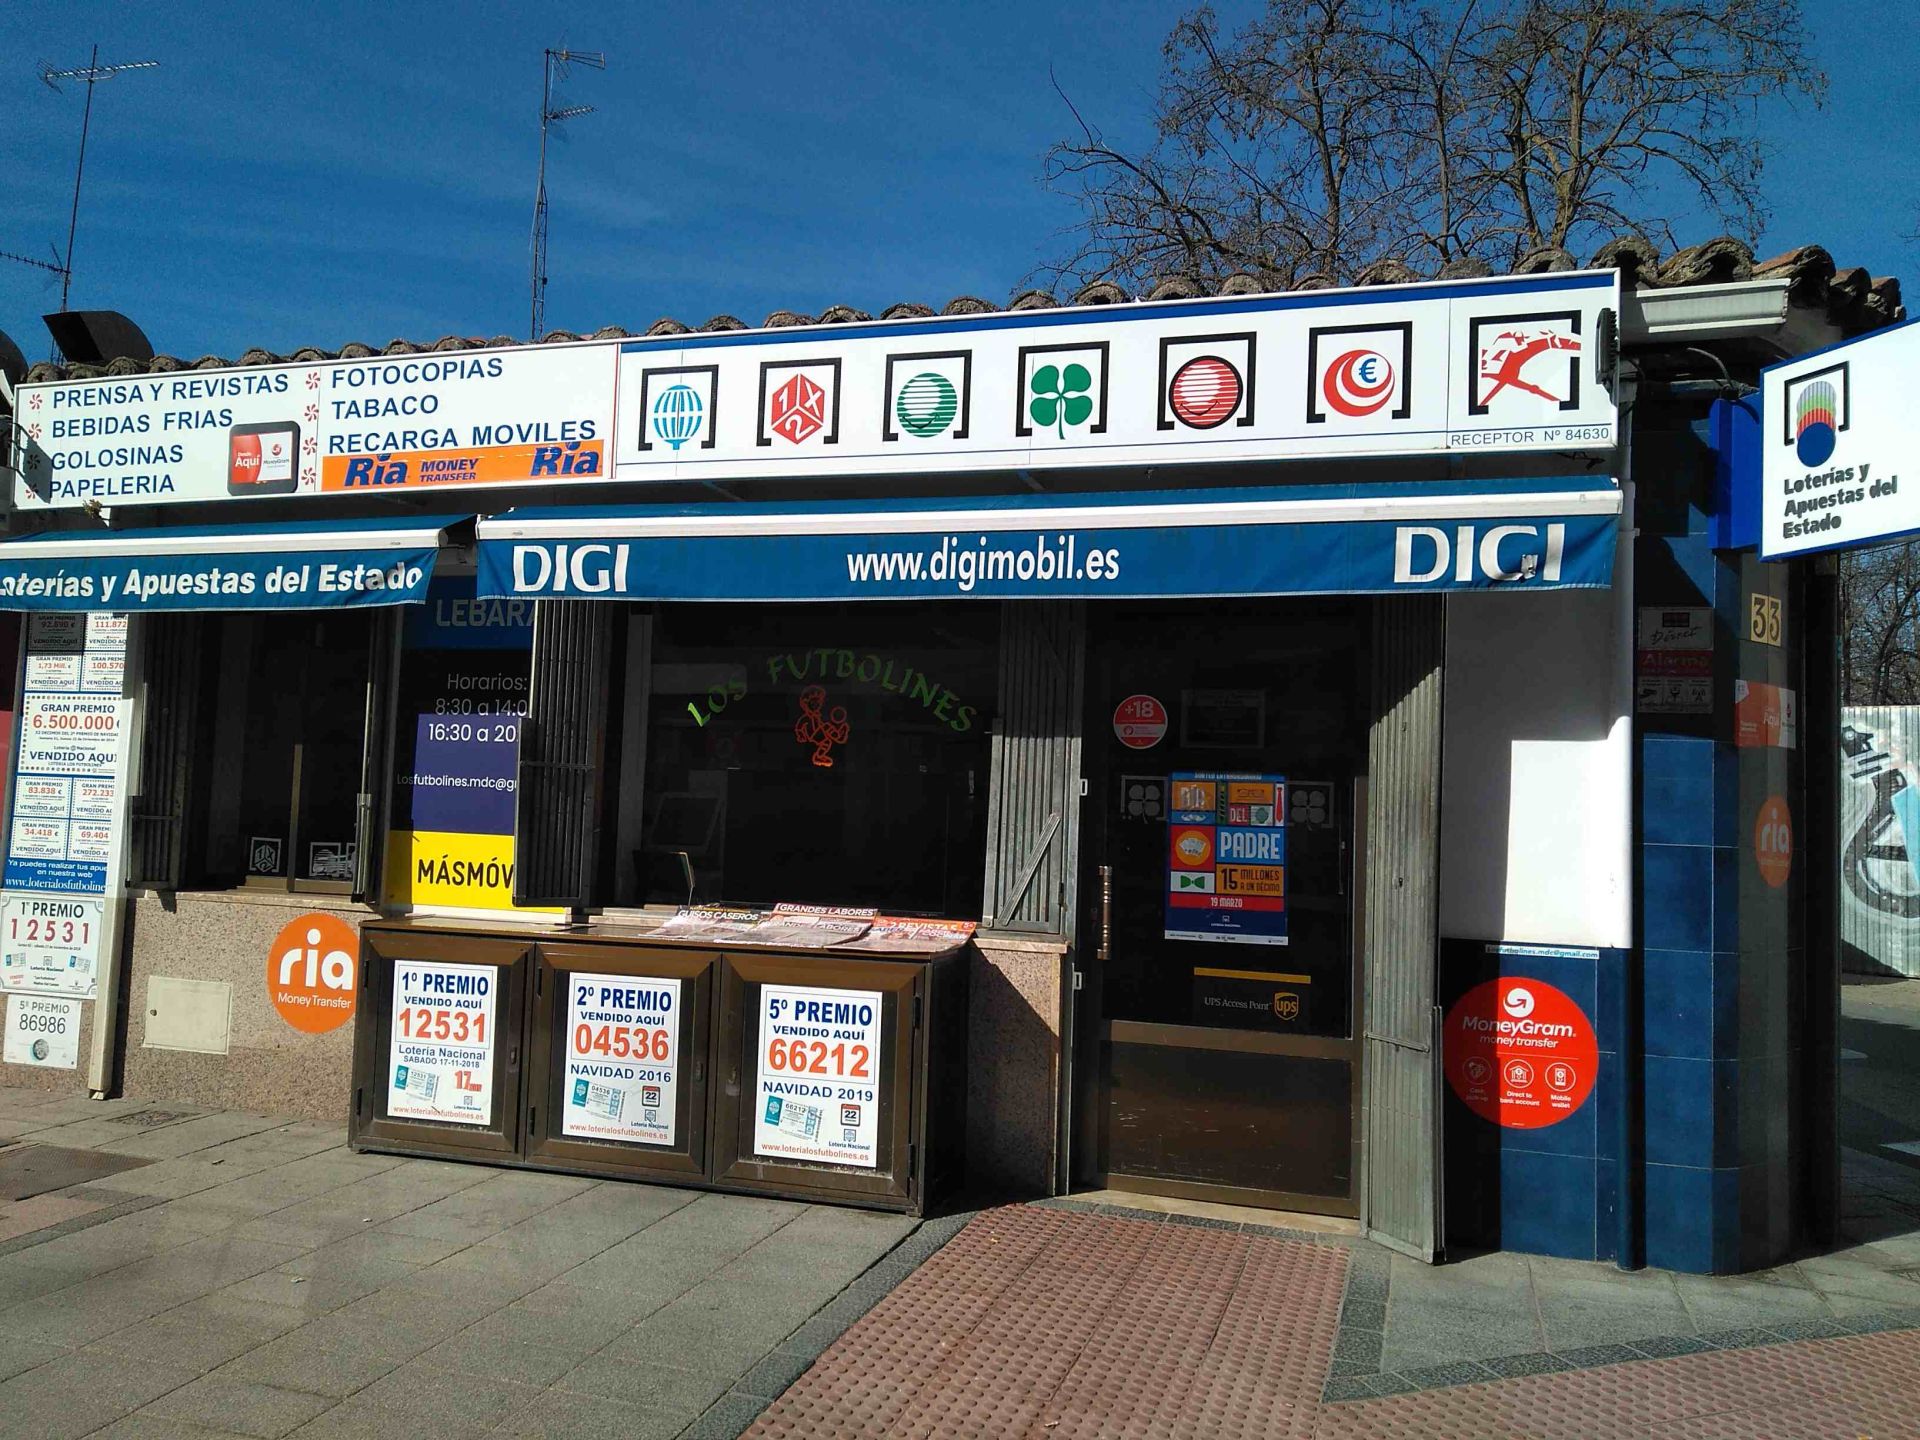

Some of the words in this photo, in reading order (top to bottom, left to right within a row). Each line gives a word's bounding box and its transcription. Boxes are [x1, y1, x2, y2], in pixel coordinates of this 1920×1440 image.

[332, 357, 503, 388] FOTOCOPIAS
[53, 385, 143, 408] PRENSA
[150, 383, 164, 401] Y
[172, 373, 289, 400] REVISTAS
[332, 394, 438, 420] TABACO
[52, 414, 150, 438] BEBIDAS
[163, 408, 233, 431] FRIAS
[329, 428, 458, 454] RECARGA
[472, 419, 596, 446] MOVILES
[1451, 431, 1534, 445] RECEPTOR
[1565, 427, 1609, 441] 84630
[51, 444, 184, 470] GOLOSINAS
[235, 454, 261, 469] Aquí
[420, 458, 479, 472] MONEY
[531, 441, 600, 476] Ria
[344, 454, 408, 486] Ria
[420, 472, 476, 482] TRANSFER
[50, 474, 175, 498] PAPELERIA
[1784, 467, 1854, 495] Loterías
[1859, 464, 1870, 482] y
[1784, 487, 1864, 518] Apuestas
[1869, 475, 1897, 499] del
[1783, 513, 1842, 538] Estado
[512, 545, 629, 592] DIGI
[847, 536, 1119, 591] www.digimobil.es
[100, 576, 116, 602] y
[123, 567, 255, 600] Apuestas
[265, 565, 307, 593] del
[319, 562, 422, 592] Estado
[1752, 596, 1781, 642] 33
[447, 673, 527, 690] Horarios:
[688, 677, 747, 728] LOS
[767, 648, 976, 731] FUTBOLINES
[41, 703, 70, 712] GRAN
[73, 704, 115, 713] PREMIO
[435, 698, 471, 716] 8:30
[477, 702, 488, 715] a
[1125, 701, 1154, 718] +18
[33, 714, 114, 730] 6.500.000
[429, 724, 471, 741] 16:30
[477, 727, 488, 742] a
[30, 751, 85, 761] VENDIDO
[1230, 808, 1248, 823] DEL
[24, 828, 52, 836] 34.418
[1760, 807, 1790, 855] ria
[1220, 832, 1280, 860] PADRE
[1221, 868, 1238, 890] 15
[1240, 869, 1280, 881] MILLONES
[32, 902, 84, 918] PREMIO
[780, 904, 827, 914] GRANDES
[828, 907, 874, 916] LABORES
[1210, 896, 1218, 907] 19
[1219, 897, 1242, 908] MARZO
[677, 909, 713, 919] GUISOS
[714, 911, 758, 920] CASEROS
[279, 928, 354, 990] ria
[423, 973, 489, 996] PREMIO
[32, 1002, 70, 1014] PREMIO
[278, 992, 311, 1007] Money
[311, 995, 351, 1008] Transfer
[404, 996, 452, 1007] VENDIDO
[455, 999, 482, 1009] AQUÍ
[577, 986, 594, 1006] 2º
[601, 988, 672, 1012] PREMIO
[1204, 997, 1221, 1006] UPS
[1222, 998, 1248, 1009] Access
[1277, 1001, 1297, 1015] ups
[580, 1011, 632, 1023] VENDIDO
[636, 1015, 664, 1026] AQUÍ
[769, 998, 788, 1019] 5º
[795, 1000, 872, 1026] PREMIO
[19, 1014, 66, 1034] 86986
[399, 1008, 485, 1042] 12531
[773, 1025, 829, 1037] VENDIDO
[833, 1029, 865, 1040] AQUÍ
[575, 1023, 669, 1061] 04536
[1480, 1034, 1514, 1047] money
[1516, 1035, 1558, 1048] transfer
[399, 1045, 435, 1057] Lotería
[439, 1047, 485, 1061] Nacional
[403, 1056, 437, 1065] SABADO
[440, 1059, 480, 1068] 17-11-2018
[769, 1039, 869, 1078] 66212
[570, 1064, 634, 1079] NAVIDAD
[639, 1070, 671, 1082] 2016
[645, 1092, 656, 1100] 22
[763, 1082, 832, 1098] NAVIDAD
[838, 1088, 873, 1101] 2019
[1550, 1094, 1572, 1102] Mobile
[845, 1111, 856, 1119] 22
[569, 1123, 668, 1140] www.loterialosfutbolines.es
[761, 1143, 869, 1161] www.loterialosfutbolines.es
